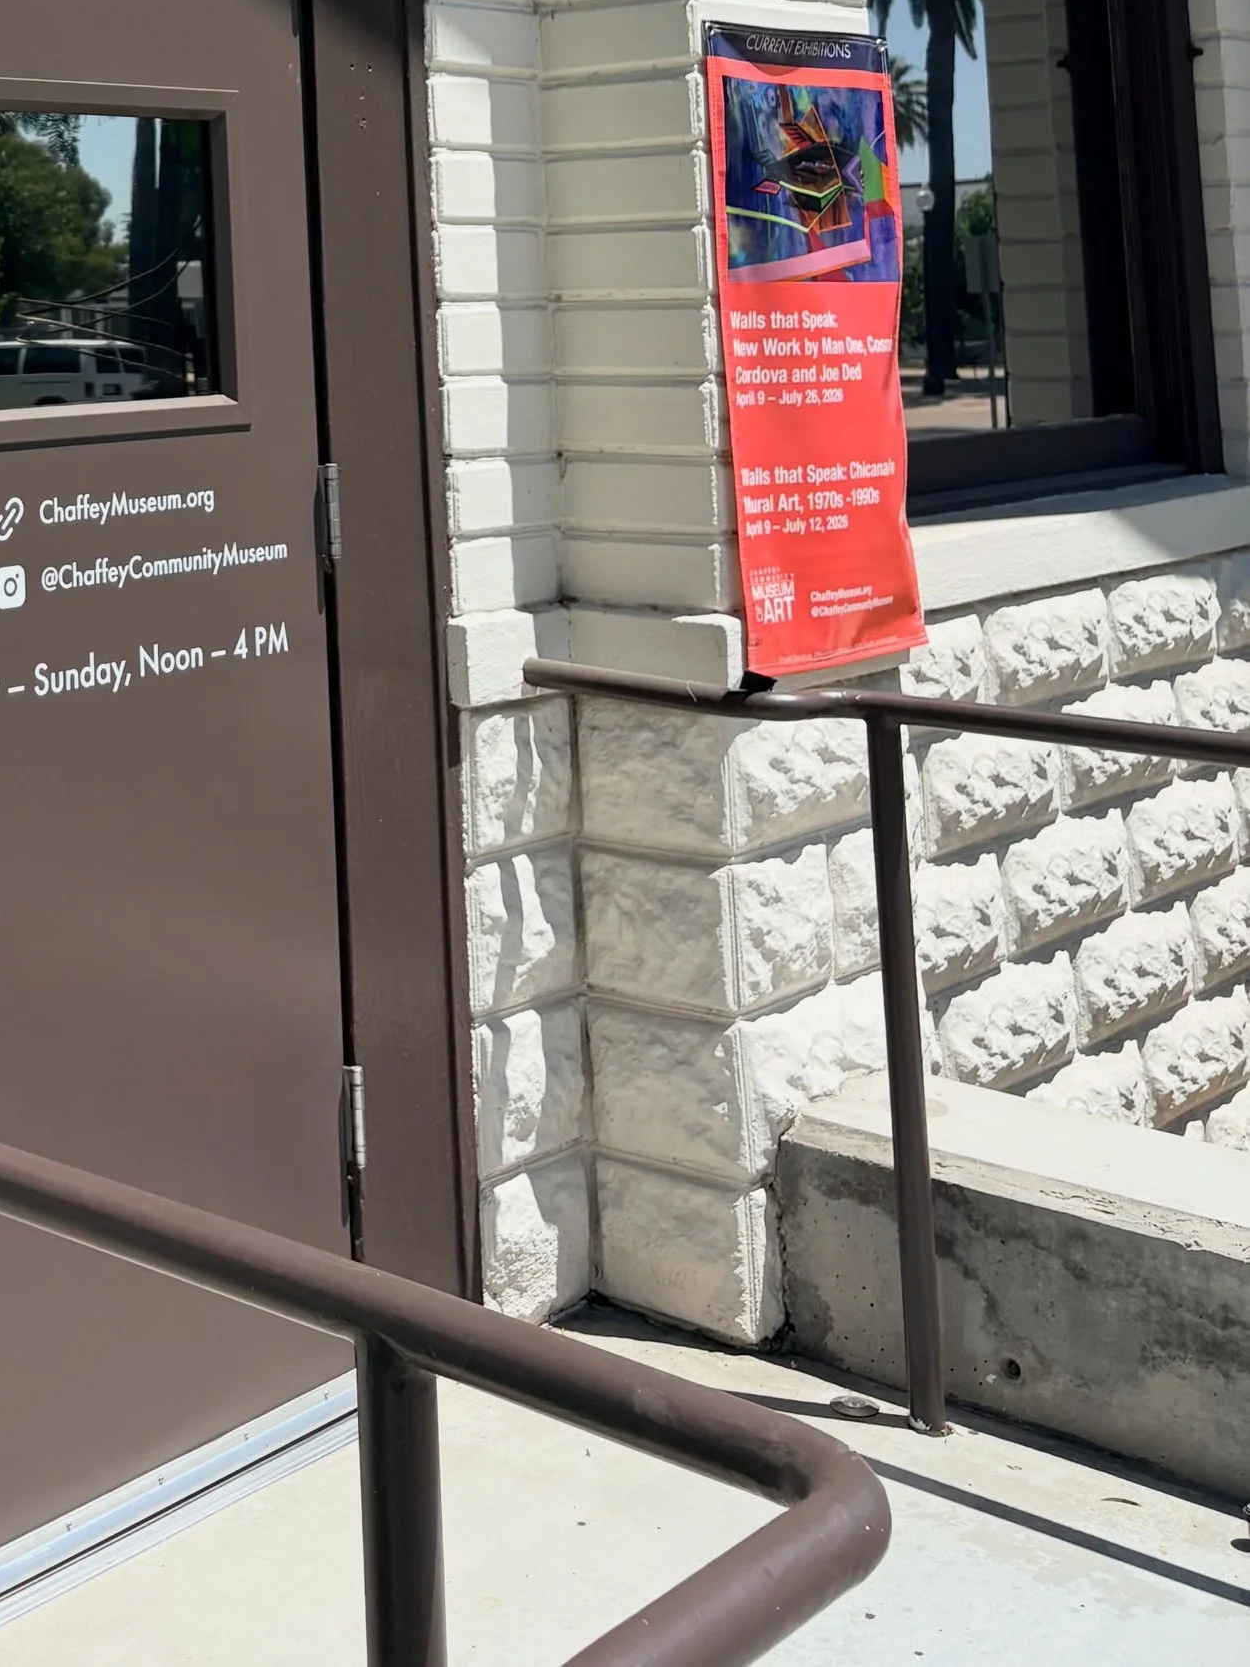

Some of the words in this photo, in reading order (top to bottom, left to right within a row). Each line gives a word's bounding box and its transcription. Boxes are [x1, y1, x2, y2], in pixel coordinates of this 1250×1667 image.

[746, 34, 795, 54] CURRENT
[793, 39, 852, 59] EXHIBITIONS
[729, 310, 766, 330] Walls
[770, 310, 799, 330] that
[801, 310, 838, 332] Speak:
[733, 338, 758, 357] New
[762, 337, 801, 356] Work
[804, 337, 819, 359] by
[821, 336, 844, 355] Man
[845, 335, 867, 356] One,
[735, 365, 787, 384] Cordova
[792, 364, 817, 383] and
[819, 363, 839, 382] Joe
[842, 362, 862, 381] Ded
[736, 390, 755, 408] April
[757, 390, 765, 406] 9
[779, 389, 802, 407] July
[805, 389, 821, 406] 26,
[741, 467, 771, 487] Walls
[773, 465, 803, 484] that
[806, 463, 847, 486] Speak:
[39, 489, 215, 526] ChaffeyMuseum.org
[744, 494, 774, 514] Mural
[778, 493, 804, 514] Art,
[807, 490, 844, 511] 1970s
[746, 519, 763, 538] April
[763, 519, 771, 535] 9
[782, 517, 807, 535] July
[809, 516, 825, 533] 12,
[41, 540, 288, 593] @ChaffeyCommunityMuseum
[751, 581, 795, 601] MUSEUM
[763, 596, 796, 625] ART
[33, 651, 132, 696] Sunday,
[138, 643, 204, 678] Noon
[233, 627, 249, 660] 4
[255, 621, 289, 656] PM
